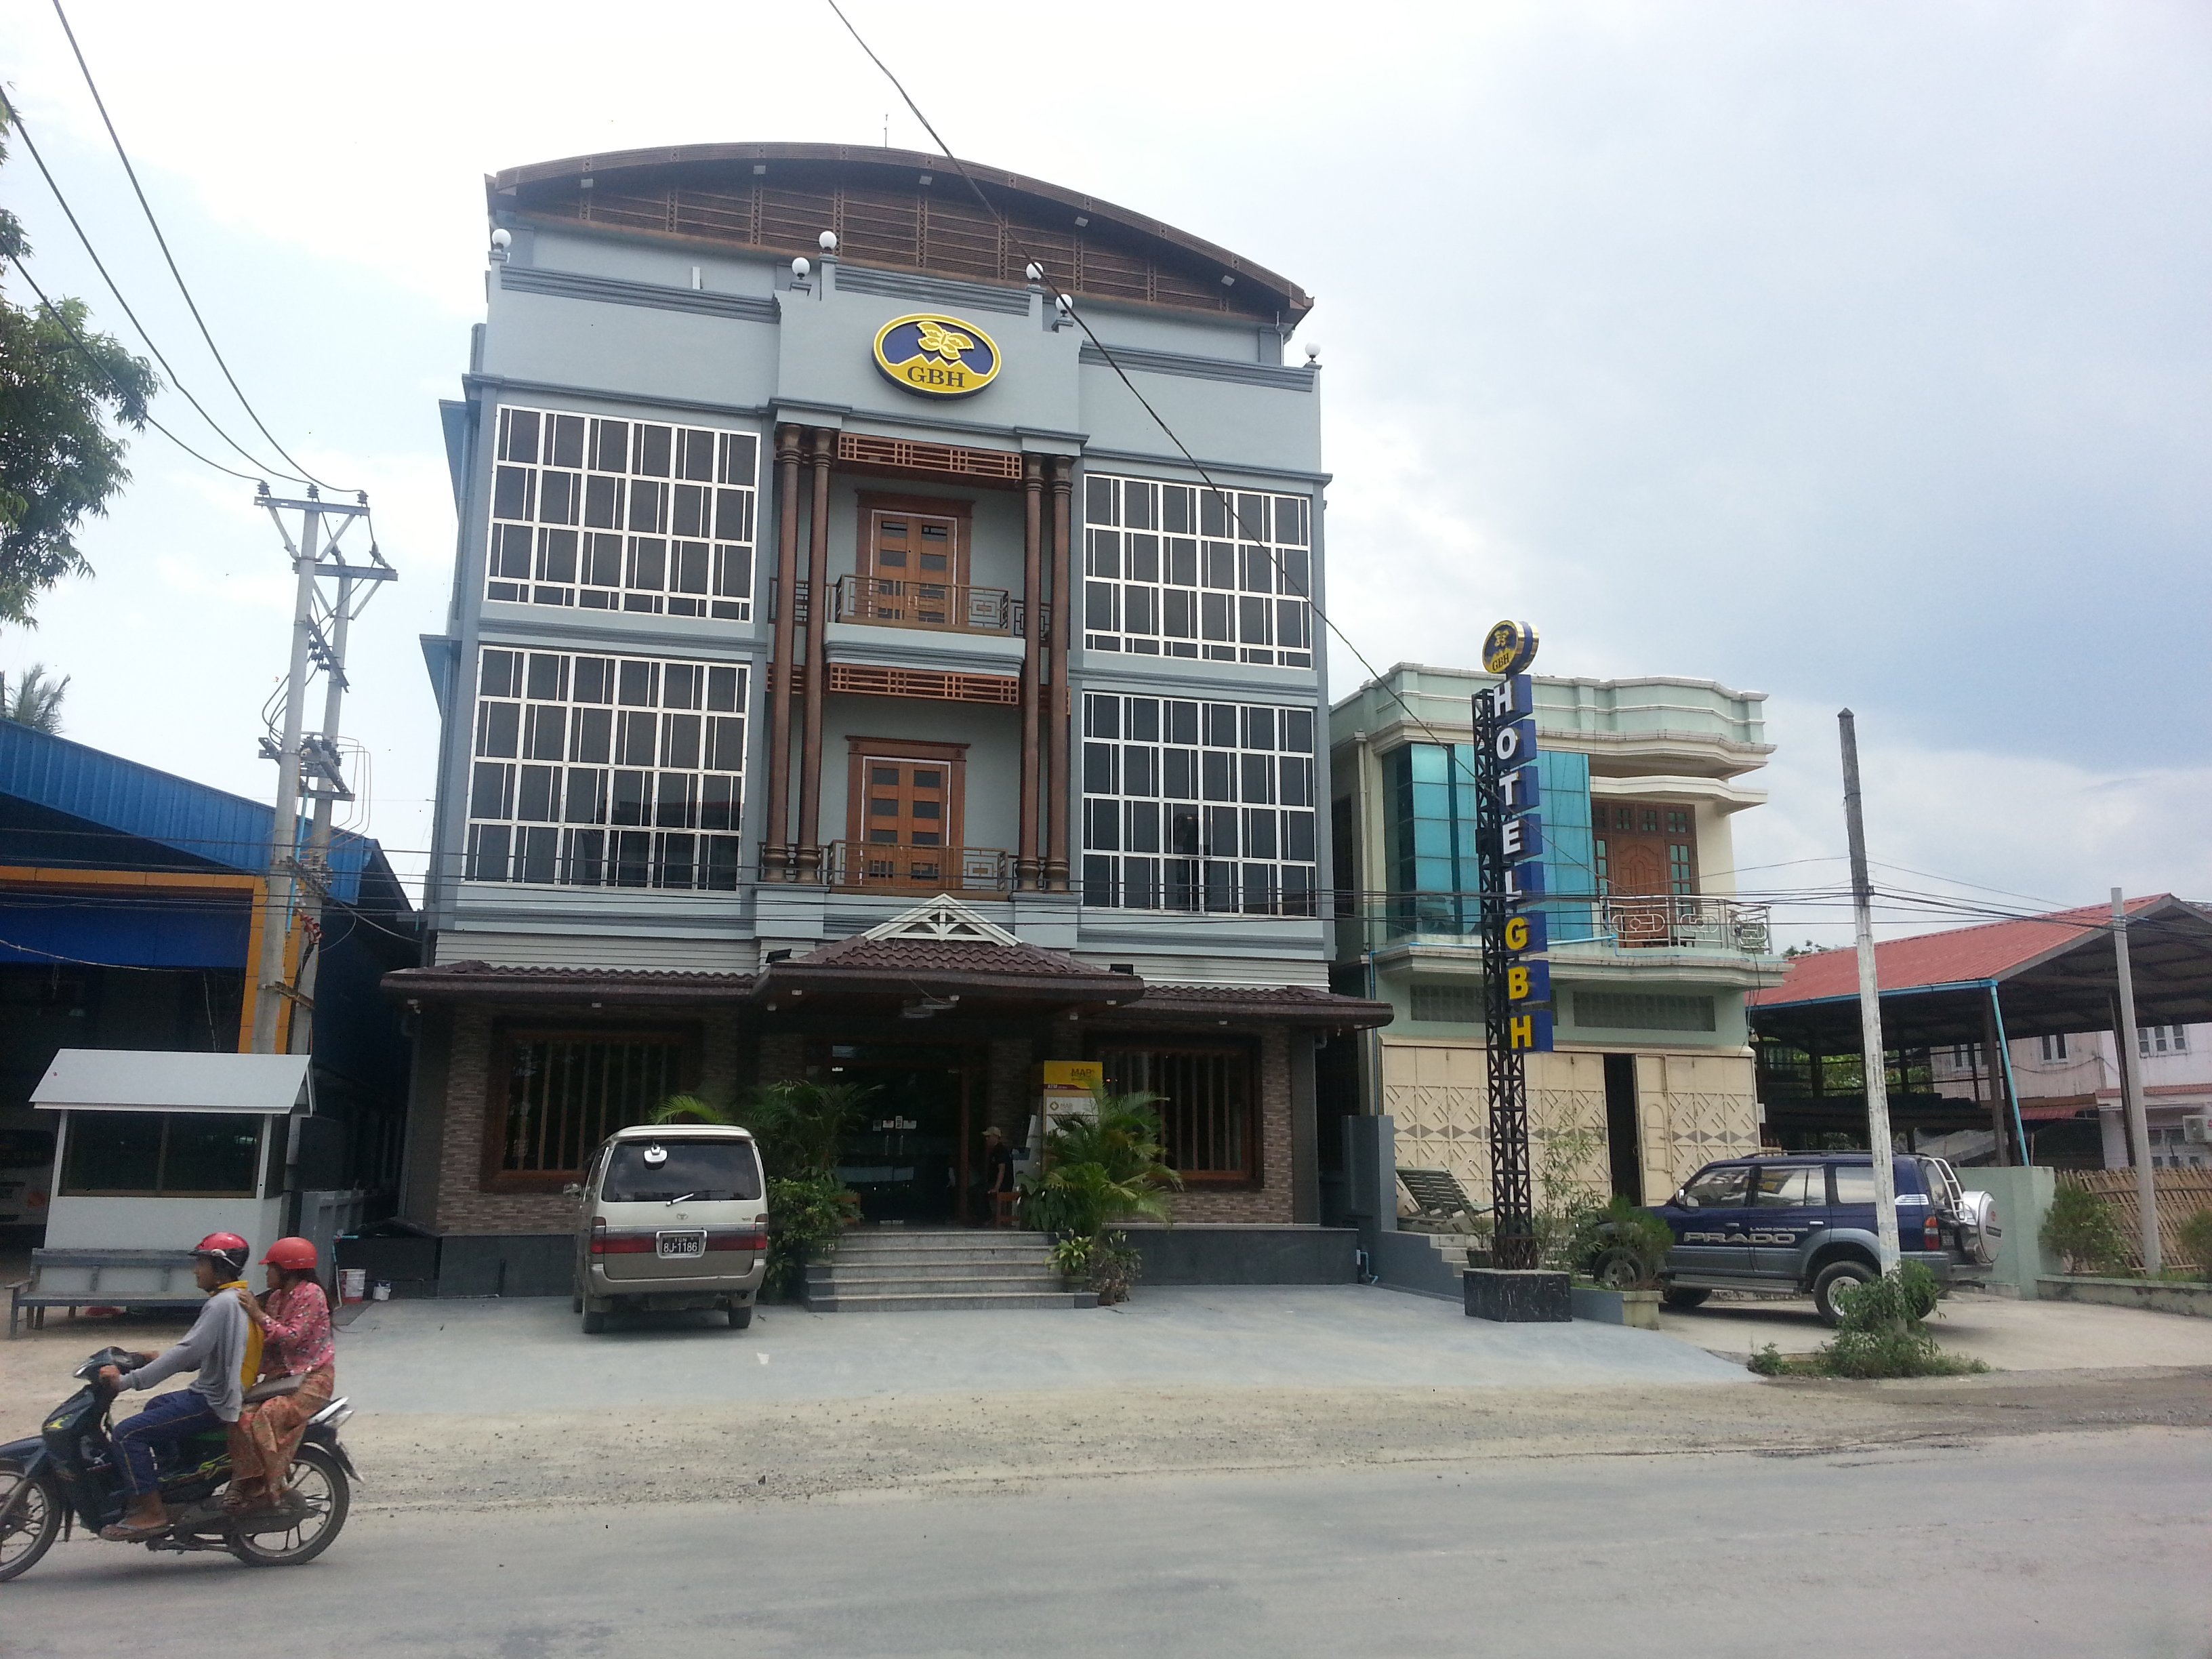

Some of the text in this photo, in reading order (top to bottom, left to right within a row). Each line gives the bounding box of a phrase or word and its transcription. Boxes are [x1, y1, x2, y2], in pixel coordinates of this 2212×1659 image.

[907, 366, 965, 388] GBH
[1492, 653, 1510, 671] GBH
[1494, 680, 1532, 1049] HOTEL GBH
[1683, 1232, 1796, 1244] PRADO
[663, 1242, 698, 1253] 8J-1186
